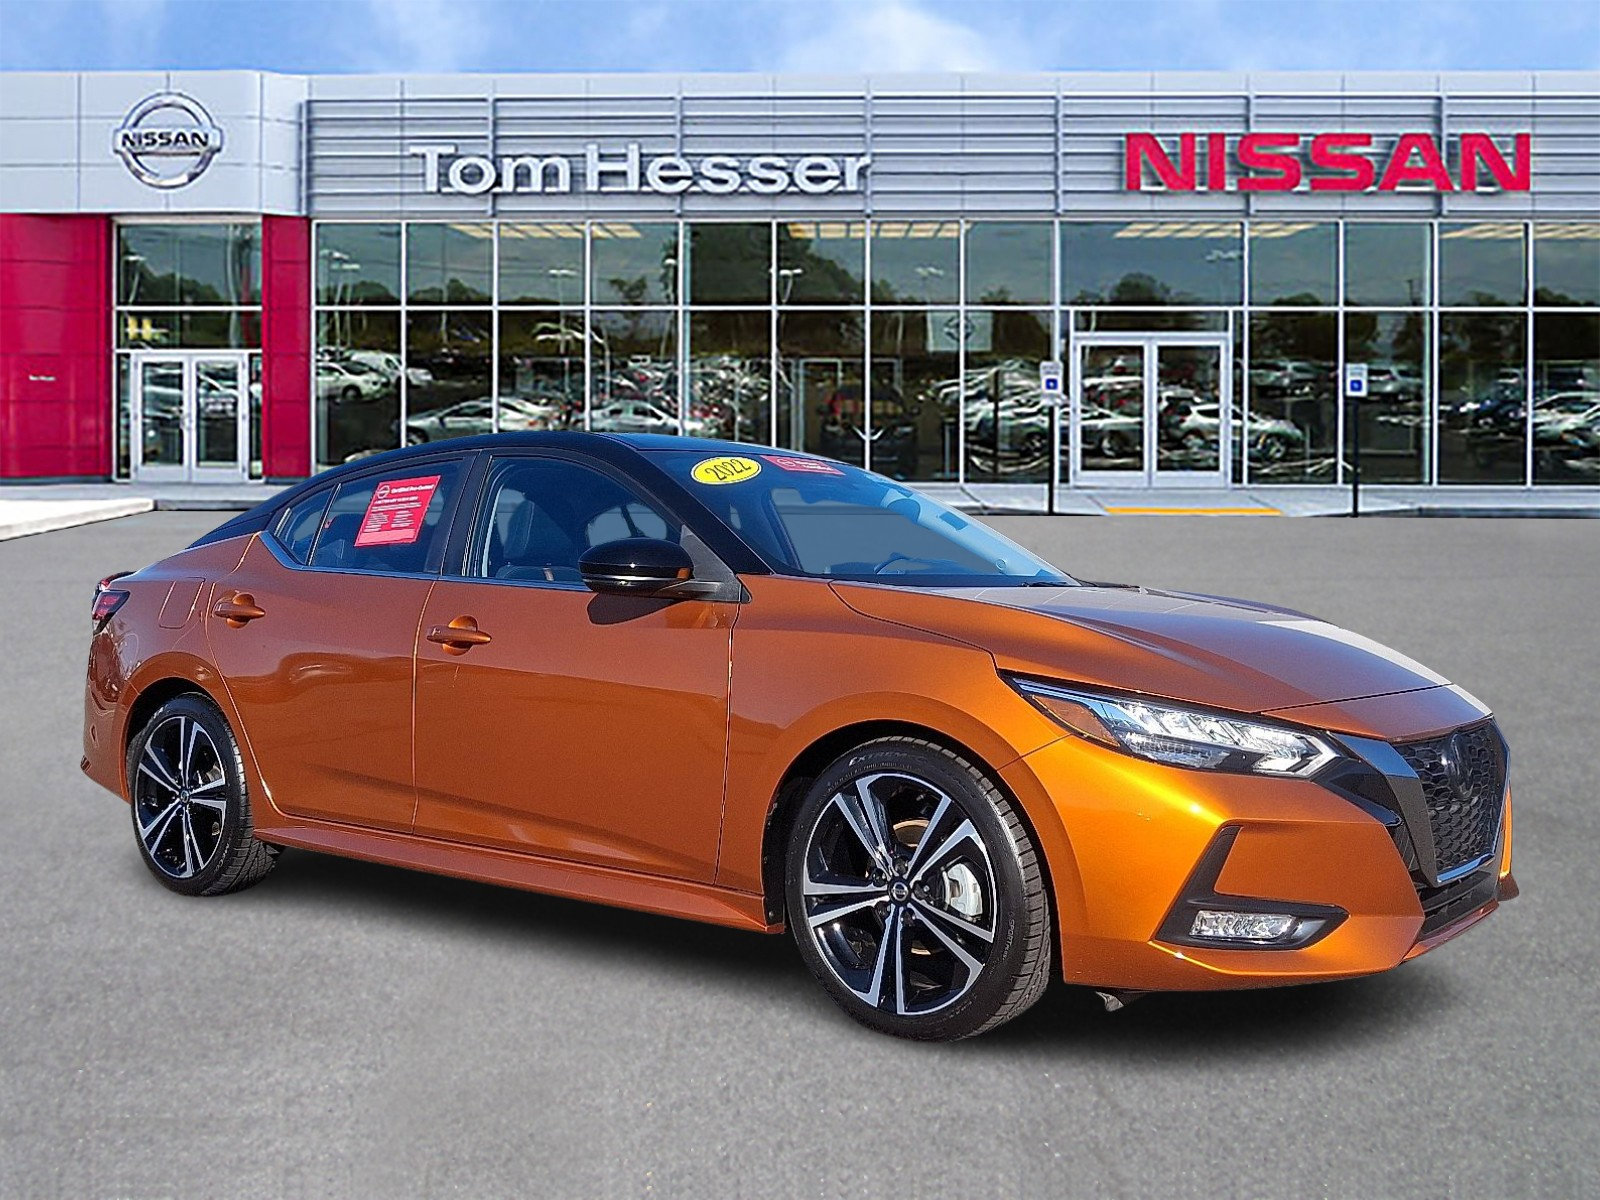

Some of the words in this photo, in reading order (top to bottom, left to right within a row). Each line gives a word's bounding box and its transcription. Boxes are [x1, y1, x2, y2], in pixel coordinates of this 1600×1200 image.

[122, 131, 209, 148] NISSAN
[409, 145, 571, 194] Tom
[585, 143, 871, 194] Hesser
[1125, 132, 1531, 191] NISSAN
[704, 458, 752, 480] 2022
